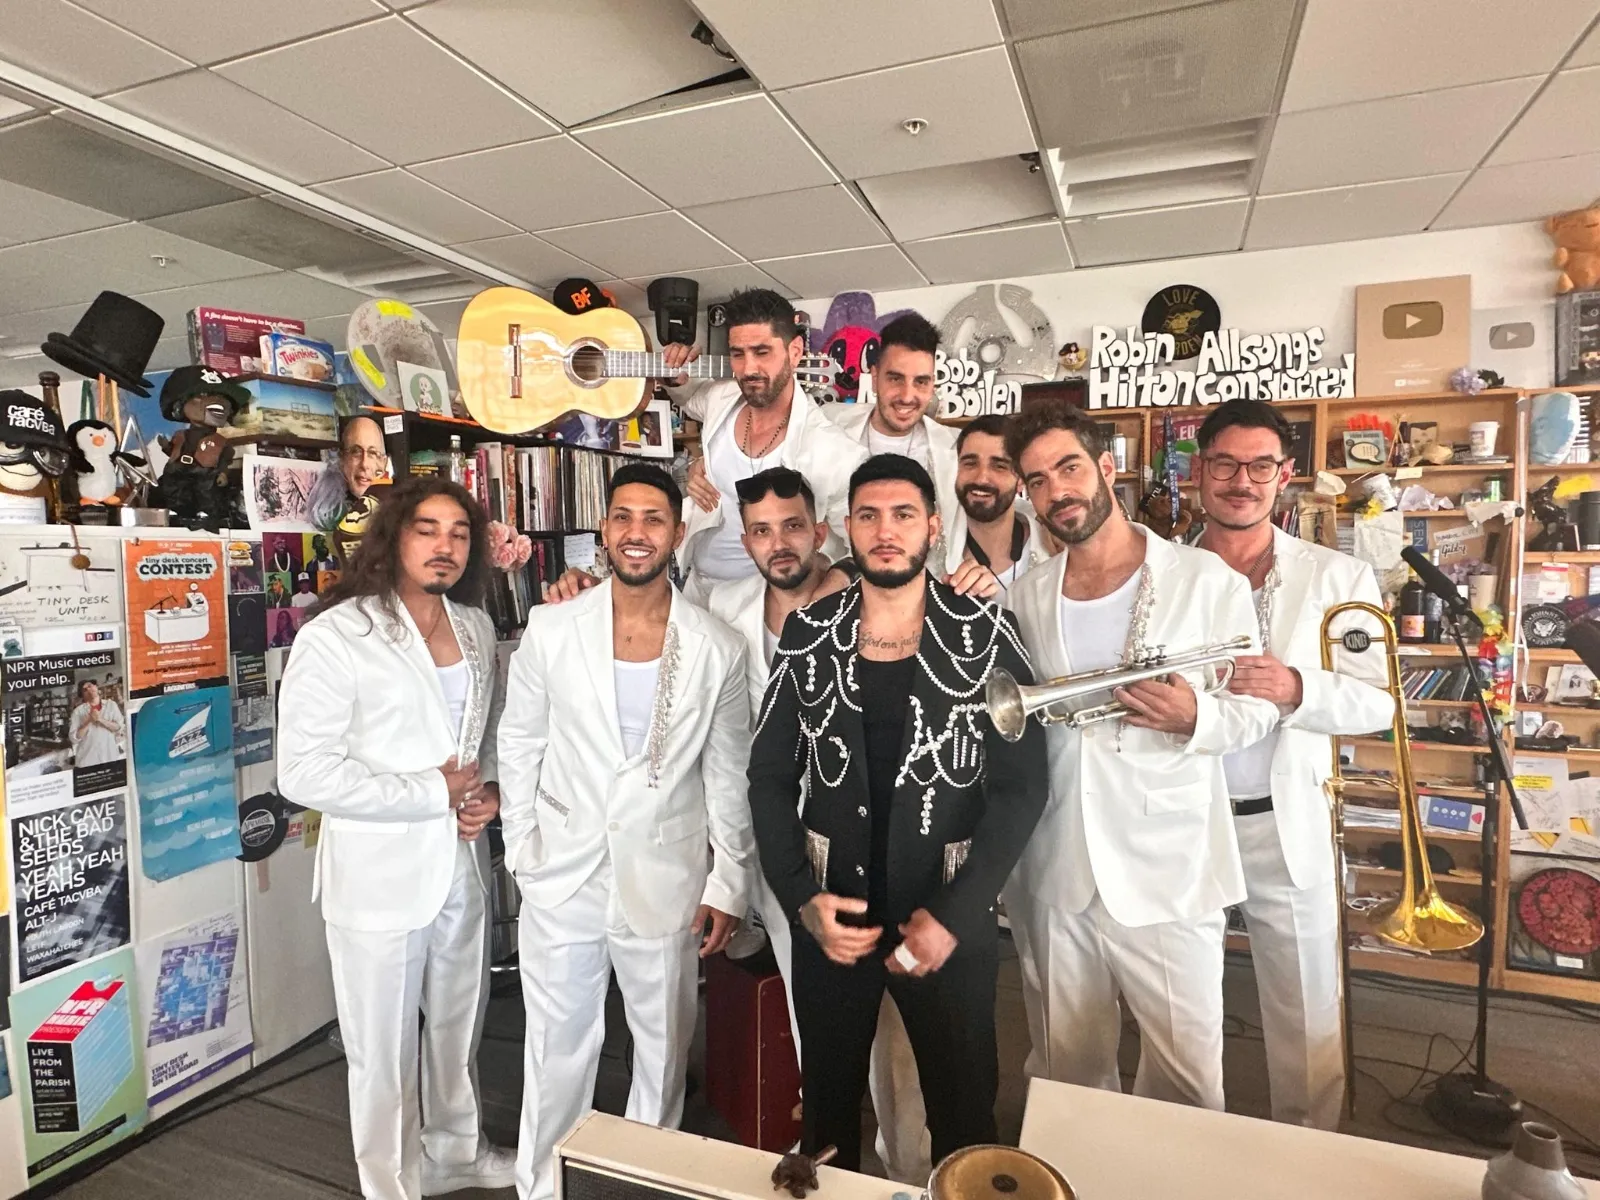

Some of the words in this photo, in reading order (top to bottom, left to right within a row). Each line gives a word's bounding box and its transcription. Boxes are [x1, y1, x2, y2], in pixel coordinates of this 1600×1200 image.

[1161, 288, 1200, 306] LOVE
[1090, 325, 1175, 368] Robin
[1196, 325, 1325, 378] Allsongs
[280, 349, 319, 365] Twinkies
[935, 347, 980, 386] Bob
[1089, 364, 1196, 409] Hilton
[1195, 353, 1355, 406] Considered
[937, 369, 1022, 419] Boilen
[139, 563, 213, 575] CONTEST
[145, 557, 160, 565] tiny
[162, 556, 180, 564] desk
[181, 556, 208, 564] concert
[37, 597, 72, 606] TINY
[79, 595, 110, 605] DESK
[58, 606, 89, 616] UNIT
[86, 632, 112, 641] npr
[1345, 633, 1368, 649] KING
[6, 660, 35, 674] NPR
[39, 657, 74, 670] Music
[76, 653, 112, 667] needs
[7, 677, 37, 692] your
[41, 673, 71, 686] help.
[174, 730, 202, 748] JAZZ
[18, 811, 67, 838] NICK
[70, 800, 117, 825] CAVE
[76, 816, 114, 839] BAD
[20, 838, 84, 869] SEEDS
[20, 860, 73, 887] YEAH
[76, 845, 124, 872] YEAH
[22, 871, 86, 903] YEAHS
[24, 896, 57, 918] CAFÉ
[58, 885, 103, 907] TACVBA
[24, 914, 58, 932] ALT-J
[26, 937, 84, 963] WAXAHATCHEE
[56, 998, 107, 1015] NPR
[45, 1014, 94, 1026] MUSIC
[31, 1048, 54, 1056] LIVE
[32, 1058, 62, 1067] FROM
[34, 1068, 54, 1077] THE
[151, 1061, 169, 1075] TINY
[169, 1051, 189, 1065] DESK
[152, 1060, 184, 1081] CONTEST
[152, 1078, 164, 1087] ON
[164, 1071, 178, 1083] THE
[178, 1058, 199, 1073] ROAD
[35, 1078, 71, 1087] PARISH
